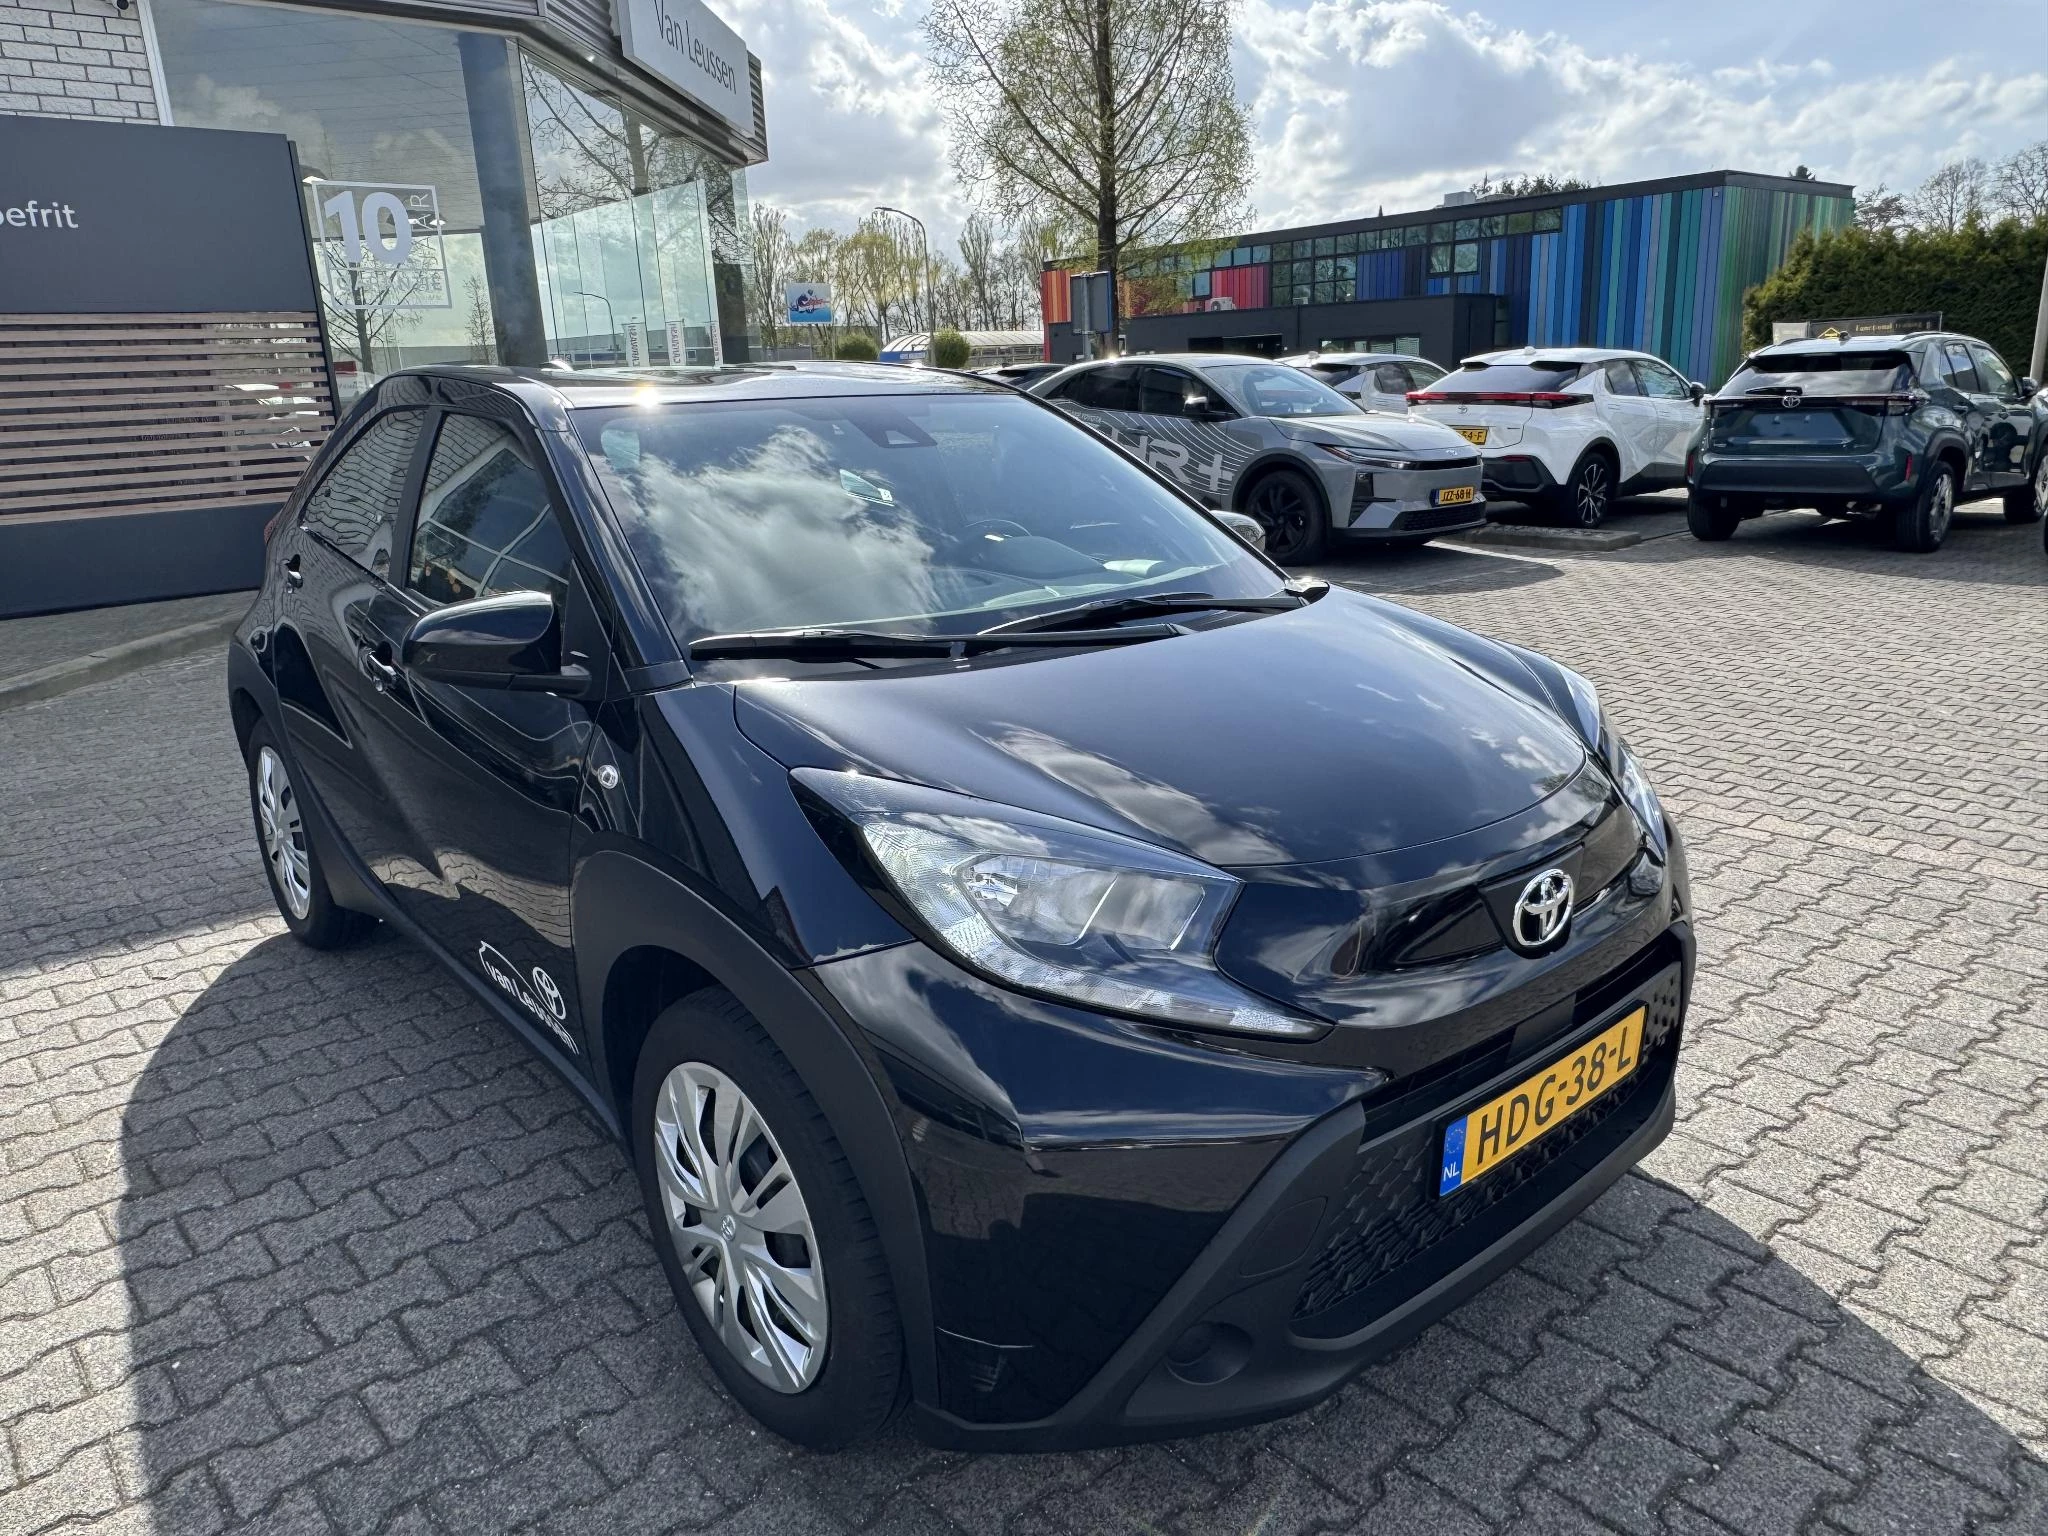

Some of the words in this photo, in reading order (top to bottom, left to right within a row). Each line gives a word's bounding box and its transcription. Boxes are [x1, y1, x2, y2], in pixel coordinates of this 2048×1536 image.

[654, 0, 684, 54] Van
[685, 20, 737, 94] Leussen
[0, 200, 79, 228] efrit
[324, 190, 413, 265] 10
[1085, 421, 1236, 492] HR+
[484, 960, 517, 997] Van
[1443, 1163, 1460, 1182] NL
[1477, 1026, 1631, 1166] HDG-38-L
